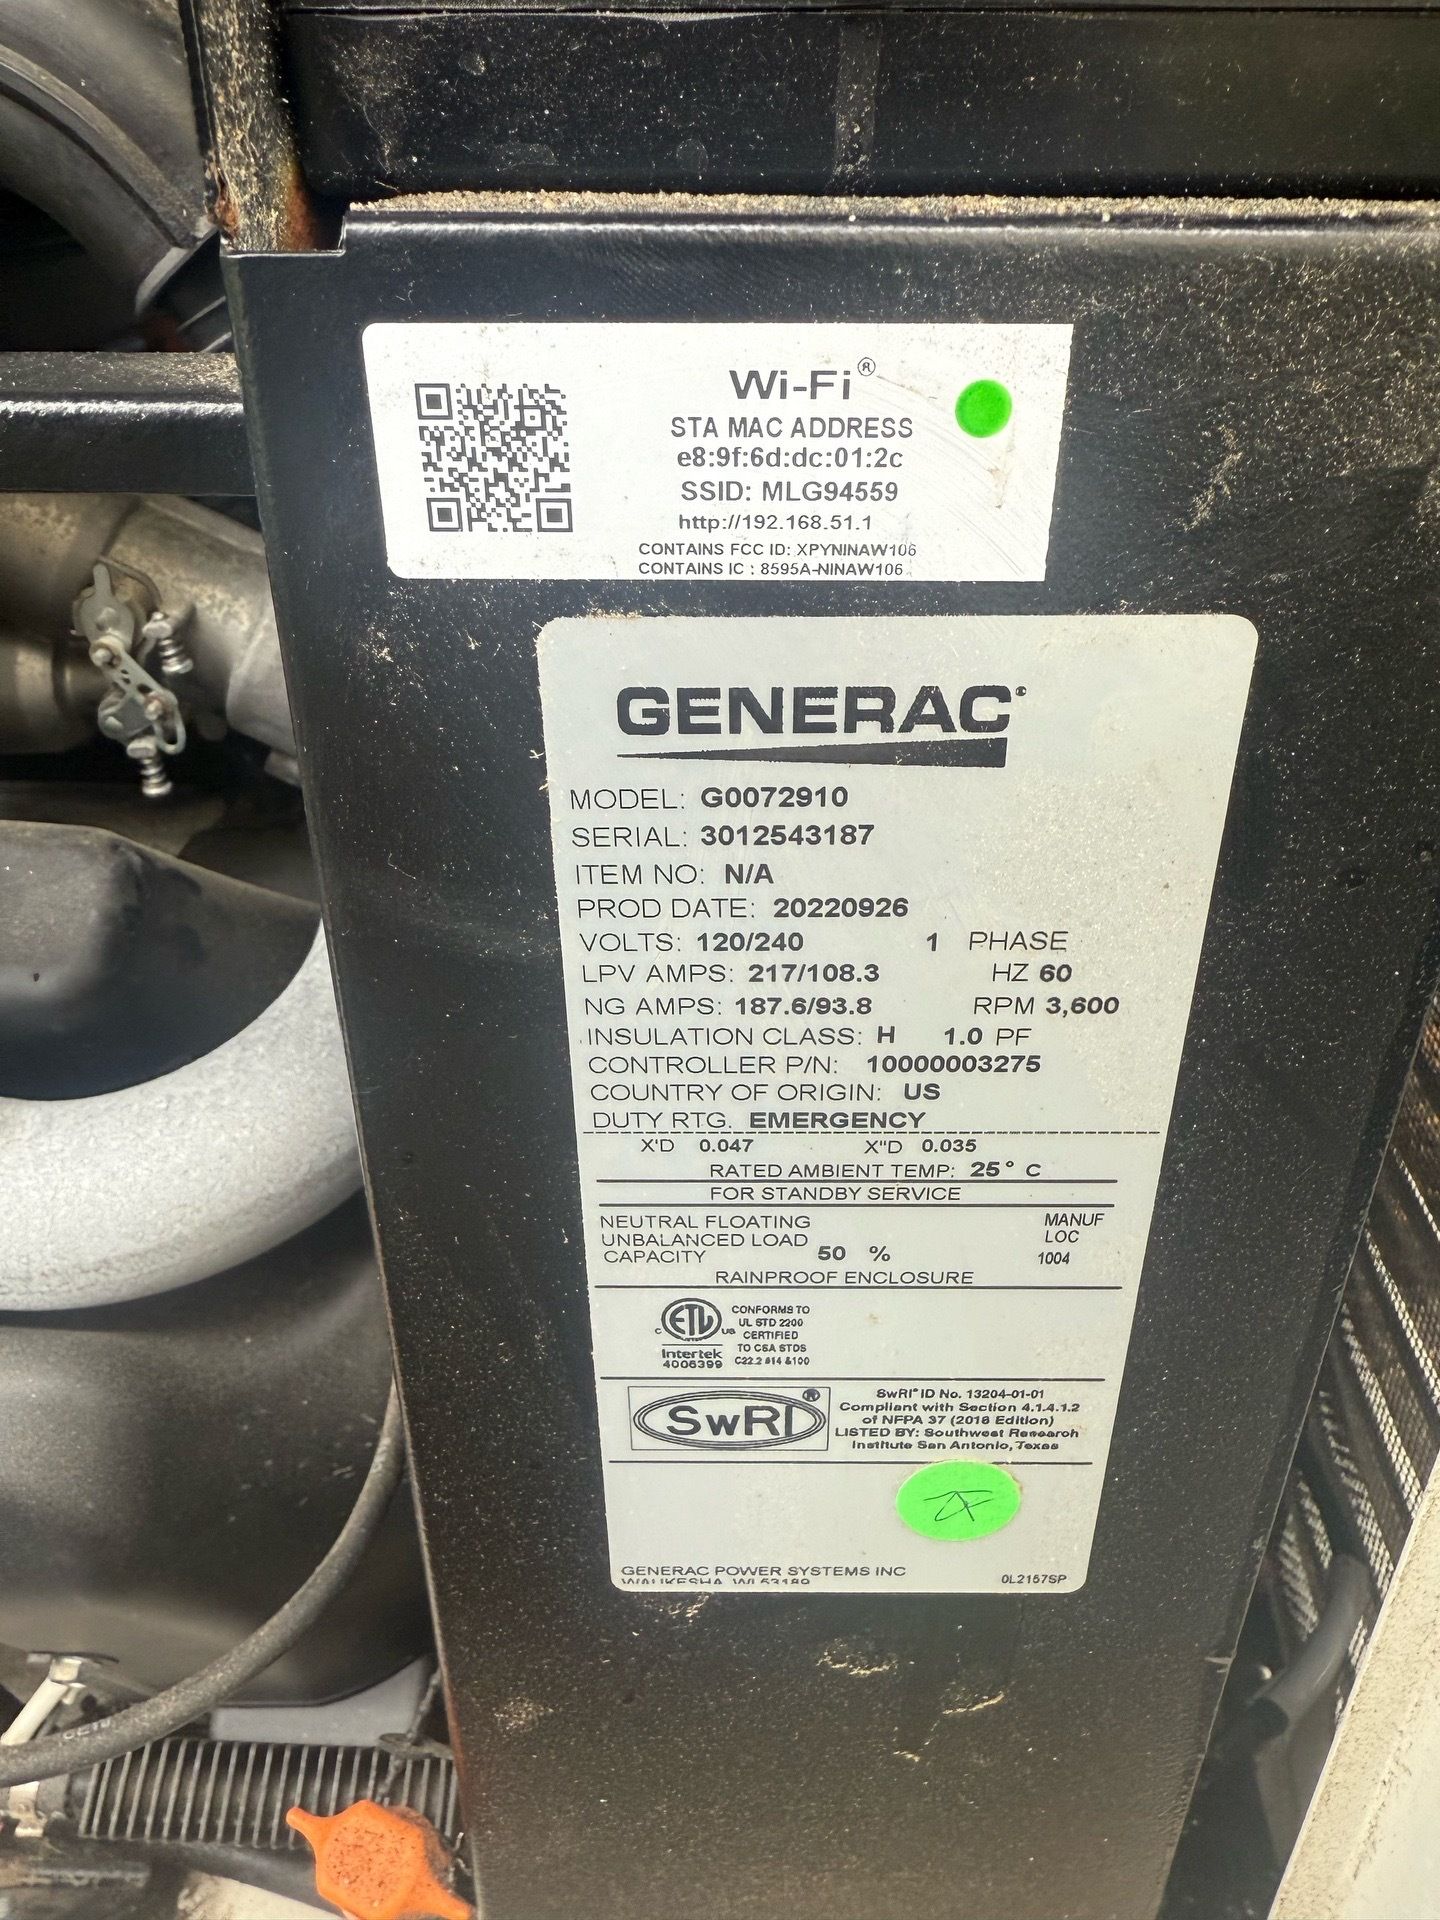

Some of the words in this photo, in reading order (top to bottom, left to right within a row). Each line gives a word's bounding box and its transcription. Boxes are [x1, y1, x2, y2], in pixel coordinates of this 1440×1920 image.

[670, 416, 719, 438] STA
[728, 416, 783, 438] MAC
[790, 416, 913, 439] ADDRESS
[677, 446, 904, 468] e8:9f:6d:dc:01:2c
[681, 480, 751, 502] SSID:
[762, 480, 898, 502] MLG94559
[678, 514, 871, 534] http://192.168.51.1
[638, 542, 724, 556] CONTAINS
[730, 543, 764, 556] FCC
[769, 543, 791, 556] ID:
[796, 543, 917, 557] XPYNINAW106
[638, 561, 724, 575] CONTAINS
[728, 562, 744, 576] IC
[760, 562, 903, 576] 8595A-NINAW106
[616, 684, 1012, 736] GENERAC
[570, 788, 685, 810] MODEL:
[700, 786, 849, 808] G0072910
[571, 826, 687, 848] SERIAL:
[700, 824, 875, 846] 3012543187
[576, 864, 642, 885] ITEM
[654, 863, 704, 885] NO:
[725, 863, 775, 885] N/A
[577, 898, 662, 919] PROD
[671, 897, 755, 919] DATE:
[773, 897, 909, 918] 20220926
[579, 932, 681, 952] VOLTS:
[697, 931, 804, 952] 120/240
[926, 932, 938, 952] 1
[969, 930, 1069, 953] PHASE
[582, 964, 636, 983] LPV
[645, 963, 733, 983] AMPS:
[748, 963, 880, 983] 217/108.3
[992, 962, 1029, 982] HZ
[1039, 963, 1073, 983] 60
[584, 997, 625, 1016] NG
[635, 997, 722, 1016] AMPS:
[735, 996, 873, 1016] 187.6/93.8
[973, 996, 1035, 1015] RPM
[1045, 996, 1120, 1018] 3,600
[588, 1027, 753, 1046] INSULATION
[762, 1027, 862, 1046] CLASS:
[877, 1025, 896, 1044] H
[944, 1027, 983, 1046] 1.0
[996, 1027, 1032, 1046] PF
[588, 1055, 776, 1074] CONTROLLER
[786, 1055, 838, 1074] P/N:
[867, 1054, 1041, 1073] 10000003275
[590, 1083, 723, 1102] COUNTRY
[731, 1083, 769, 1101] OF
[777, 1083, 881, 1102] ORIGIN:
[904, 1082, 941, 1101] US
[593, 1111, 663, 1129] DUTY
[672, 1111, 732, 1129] RTG.
[749, 1111, 927, 1129] EMERGENCY
[640, 1138, 675, 1153] X'D
[699, 1138, 754, 1153] 0.047
[921, 1138, 977, 1153] 0.035
[710, 1163, 783, 1178] RATED
[787, 1164, 885, 1178] AMBIENT
[890, 1164, 955, 1178] TEMP:
[1025, 1163, 1042, 1178] C
[710, 1186, 755, 1201] FOR
[761, 1186, 862, 1201] STANDBY
[867, 1186, 962, 1201] SERVICE
[600, 1215, 699, 1229] NEUTRAL
[705, 1215, 811, 1229] FLOATING
[1044, 1212, 1105, 1227] MANUF
[601, 1233, 745, 1247] UNBALANCED
[751, 1233, 808, 1247] LOAD
[1044, 1229, 1080, 1244] LOC
[603, 1249, 706, 1264] CAPACITY
[817, 1245, 846, 1261] 50
[869, 1245, 891, 1262] %
[1037, 1251, 1070, 1265] 1004
[715, 1270, 838, 1285] RAINPROOF
[844, 1271, 975, 1285] ENCLOSURE
[731, 1305, 794, 1315] CONFORMS
[795, 1305, 811, 1315] TO
[738, 1317, 753, 1328] UL
[755, 1317, 777, 1328] STD
[778, 1318, 804, 1328] 2200
[742, 1330, 799, 1340] CERTIFIED
[661, 1348, 723, 1360] Intertek
[737, 1343, 752, 1353] TO
[753, 1343, 777, 1353] CSA
[778, 1343, 807, 1353] STDS
[734, 1356, 763, 1366] C22.2
[784, 1356, 810, 1366] &100
[920, 1388, 936, 1399] ID
[939, 1388, 962, 1399] No.
[966, 1388, 1044, 1399] 13204-01-01
[839, 1401, 918, 1414] Compliant
[921, 1401, 954, 1412] with
[958, 1402, 1017, 1413] Section
[1021, 1402, 1081, 1413] 4.1.4.1.2
[861, 1414, 878, 1425] of
[881, 1414, 924, 1425] NFPA
[927, 1415, 947, 1425] 37
[995, 1415, 1055, 1428] Edition)
[834, 1427, 891, 1438] LISTED
[894, 1427, 920, 1438] BY:
[923, 1427, 1005, 1438] Southwest
[1008, 1428, 1079, 1438] Research
[852, 1440, 913, 1450] Institute
[917, 1440, 947, 1450] San
[949, 1440, 1013, 1452] Antonio,
[1014, 1440, 1059, 1450] Texas
[620, 1565, 710, 1576] GENERAC
[714, 1565, 782, 1576] POWER
[787, 1566, 871, 1577] SYSTEMS
[875, 1566, 906, 1577] INC
